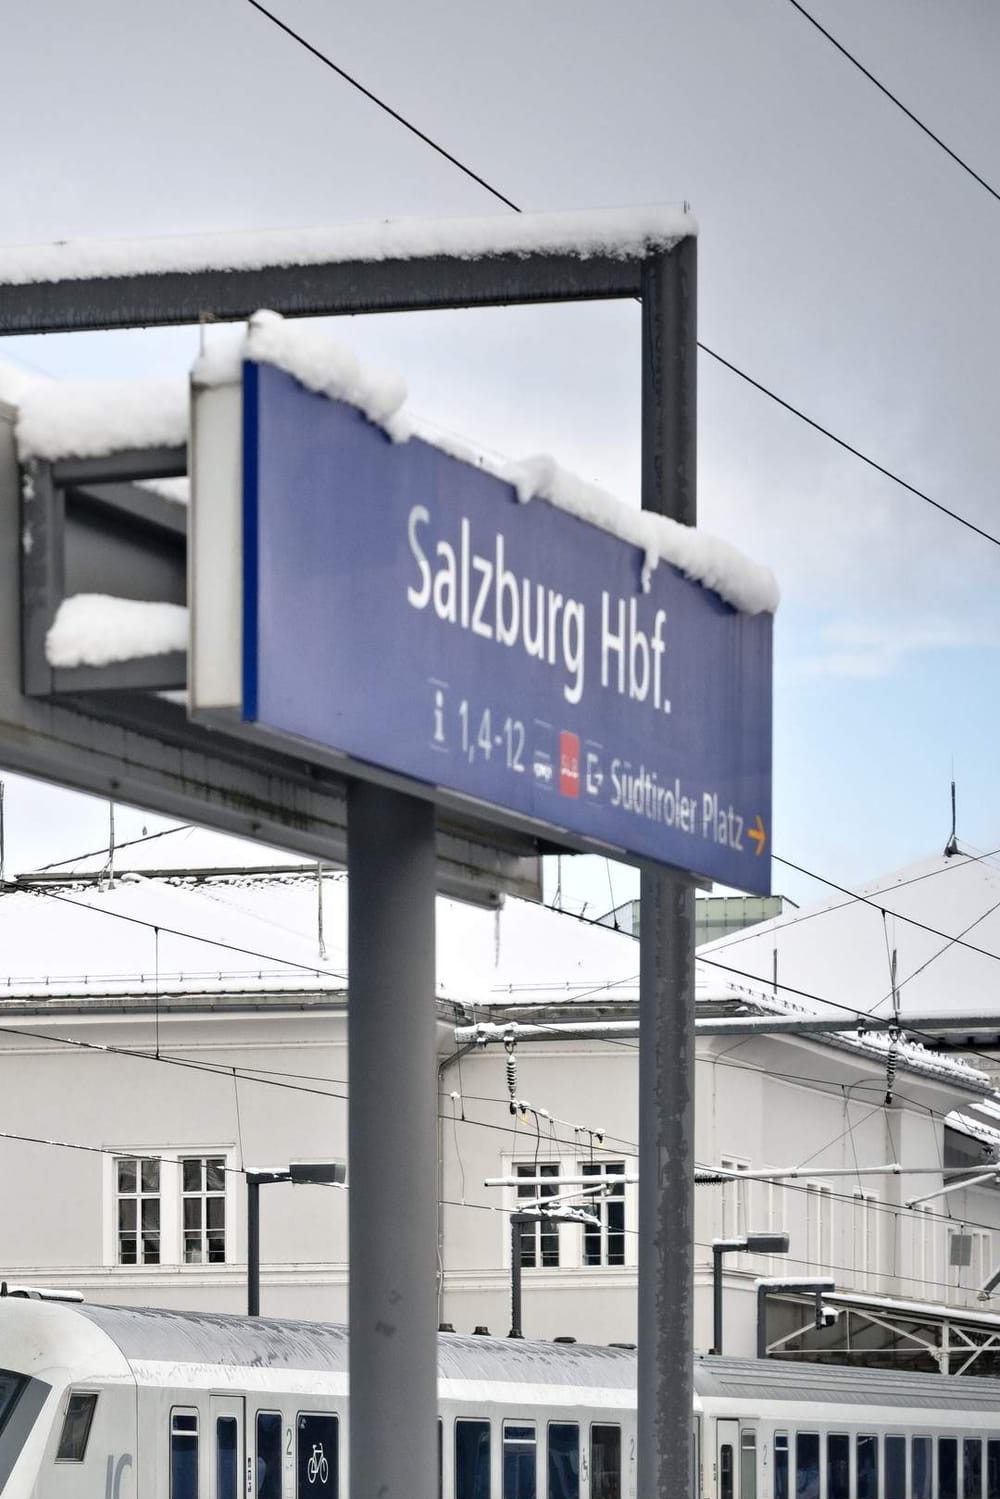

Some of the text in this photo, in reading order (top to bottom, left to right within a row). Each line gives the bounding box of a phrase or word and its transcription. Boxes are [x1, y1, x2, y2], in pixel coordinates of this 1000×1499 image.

[407, 505, 671, 714] Salzburg Hbf.
[611, 758, 697, 833] Südtiroler
[702, 792, 744, 851] Platz
[286, 1428, 292, 1456] 2
